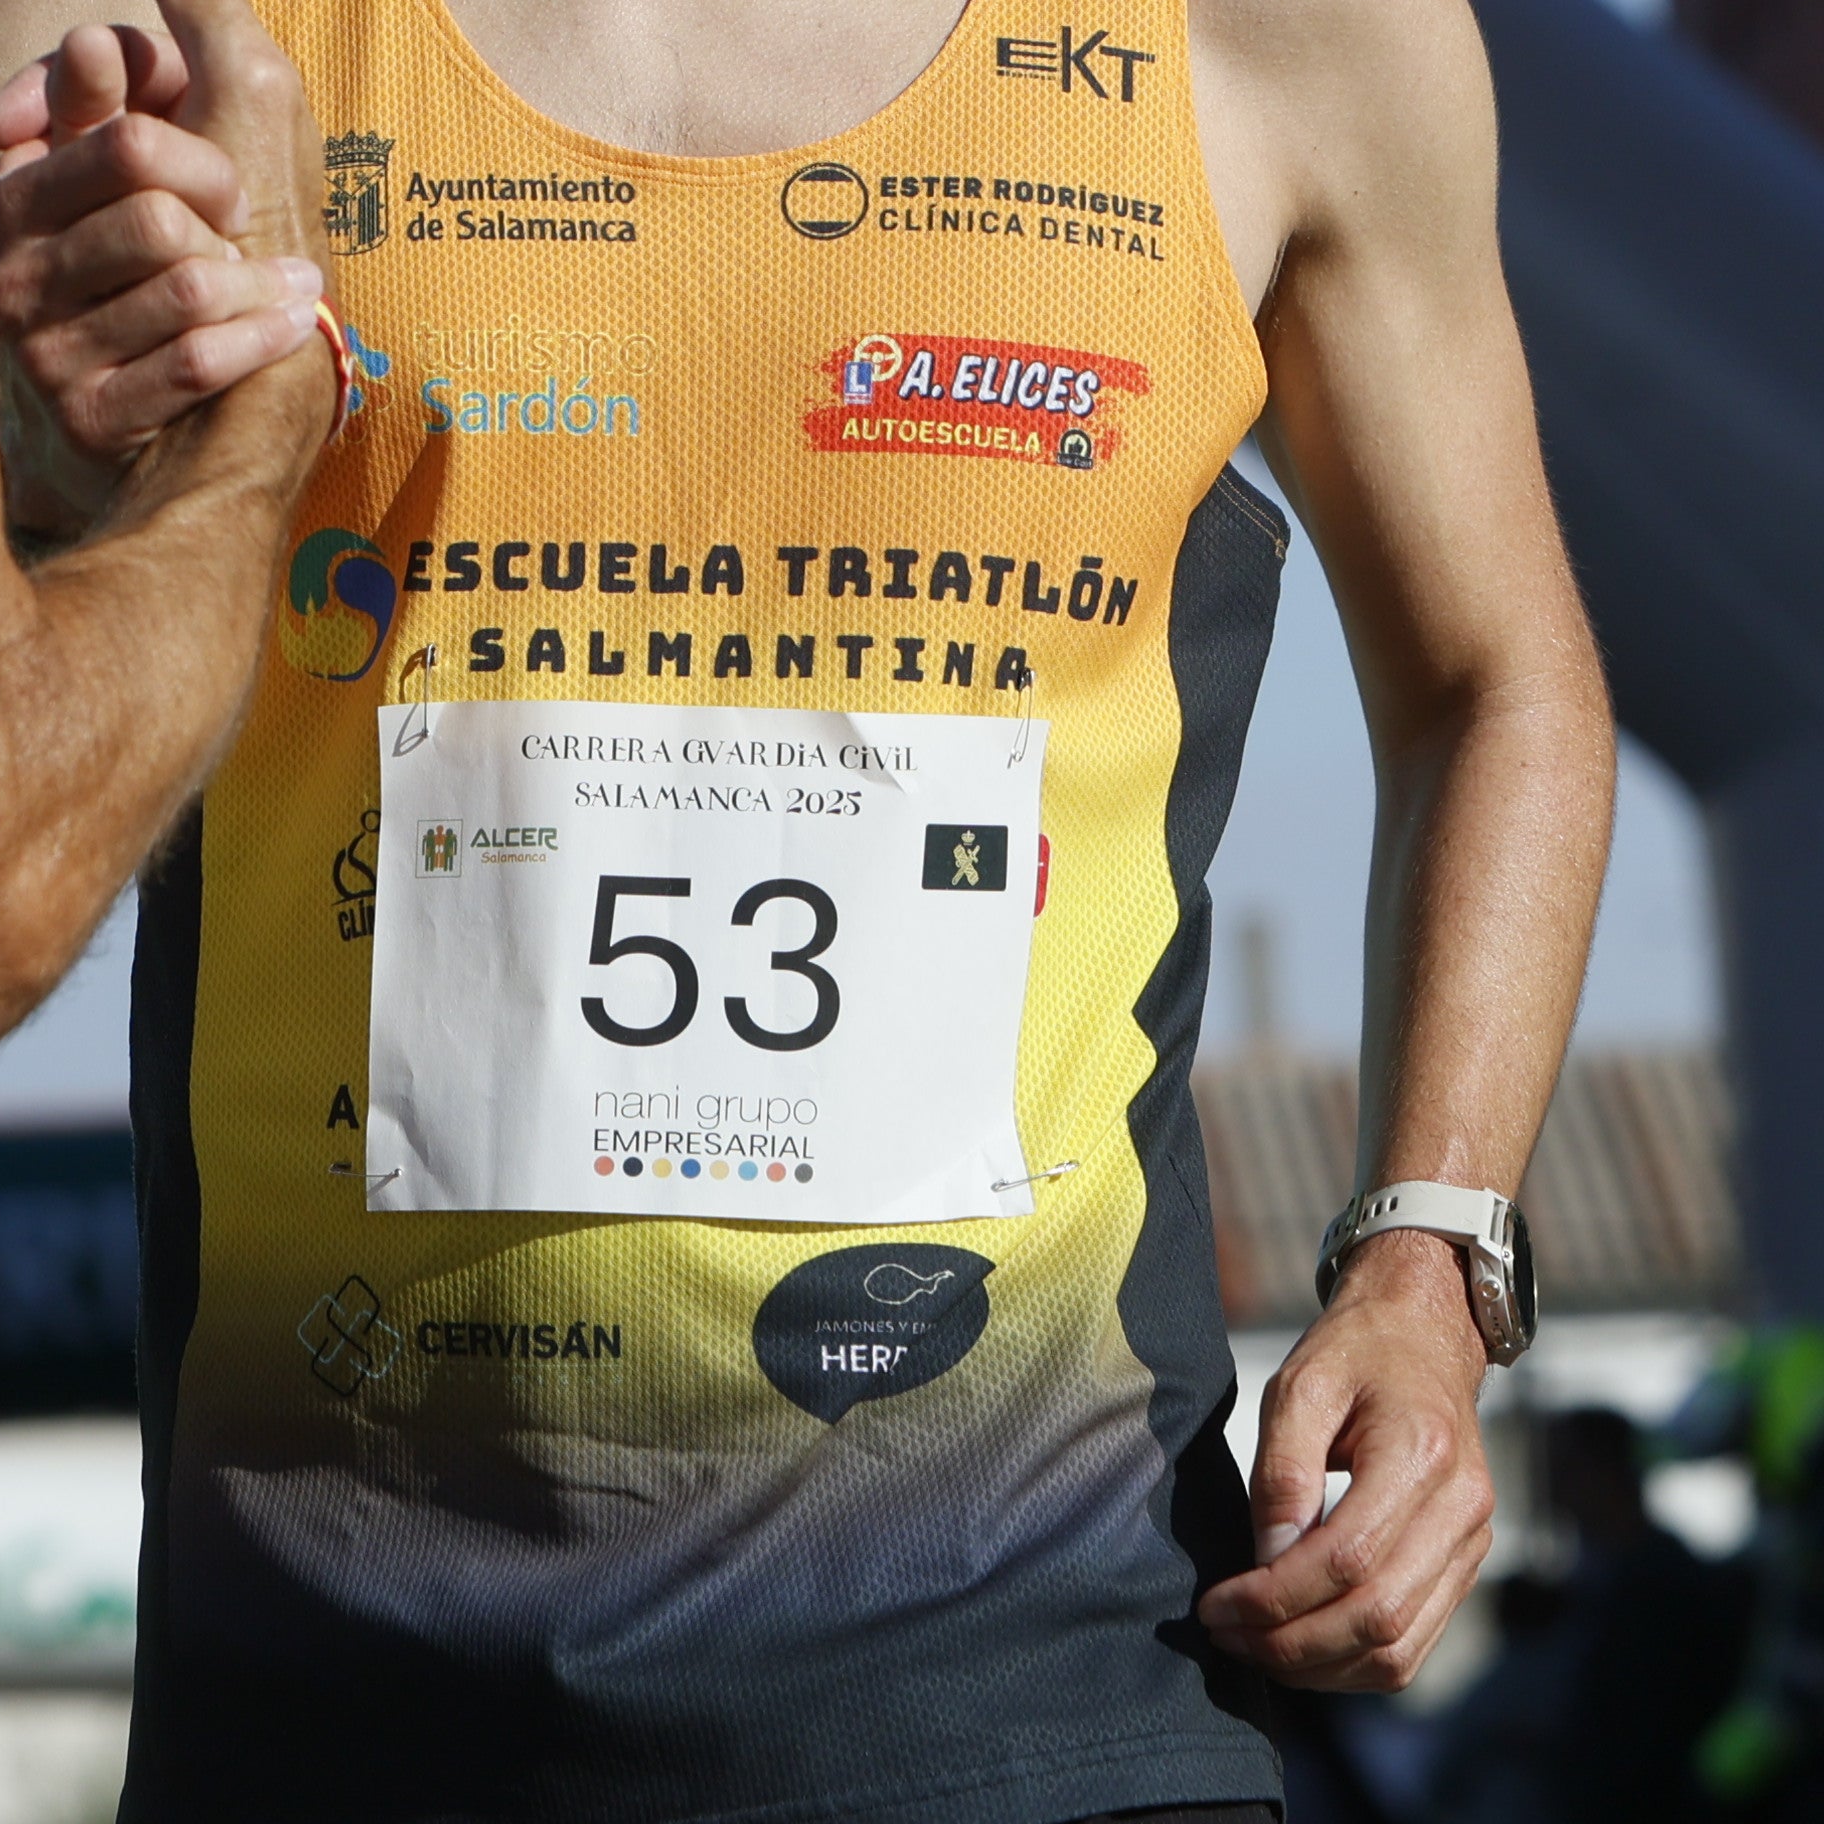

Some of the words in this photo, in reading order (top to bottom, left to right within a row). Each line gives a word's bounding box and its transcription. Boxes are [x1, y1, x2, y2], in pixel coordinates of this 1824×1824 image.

[996, 26, 1156, 102] EKT
[406, 172, 636, 207] Ayuntamiento
[880, 177, 982, 199] ESTER
[993, 178, 1165, 227] RODRÍGUEZ
[406, 212, 444, 242] de
[456, 210, 637, 242] Salamanca
[879, 204, 1025, 236] CLÍNICA
[1039, 217, 1165, 262] DENTAL
[898, 351, 945, 400] A.
[951, 354, 1100, 418] ELICES
[420, 376, 638, 435] Sardón
[842, 418, 1042, 453] AUTOESCUELA
[403, 541, 745, 596] ESCUELA
[776, 546, 1139, 627] TRIATLÓN
[469, 628, 1036, 691] SALMANTINA
[521, 735, 674, 764] CARRERA
[575, 782, 774, 813] SALAMANCA
[785, 788, 863, 816] 2025
[470, 827, 559, 851] ALCER
[480, 851, 547, 865] Salamanca
[580, 874, 841, 1053] 53
[594, 1084, 679, 1120] nani
[696, 1094, 818, 1131] grupo
[593, 1128, 815, 1159] EMPRESARIAL
[418, 1320, 622, 1359] CERVISÁN
[814, 1320, 894, 1334] JAMONES
